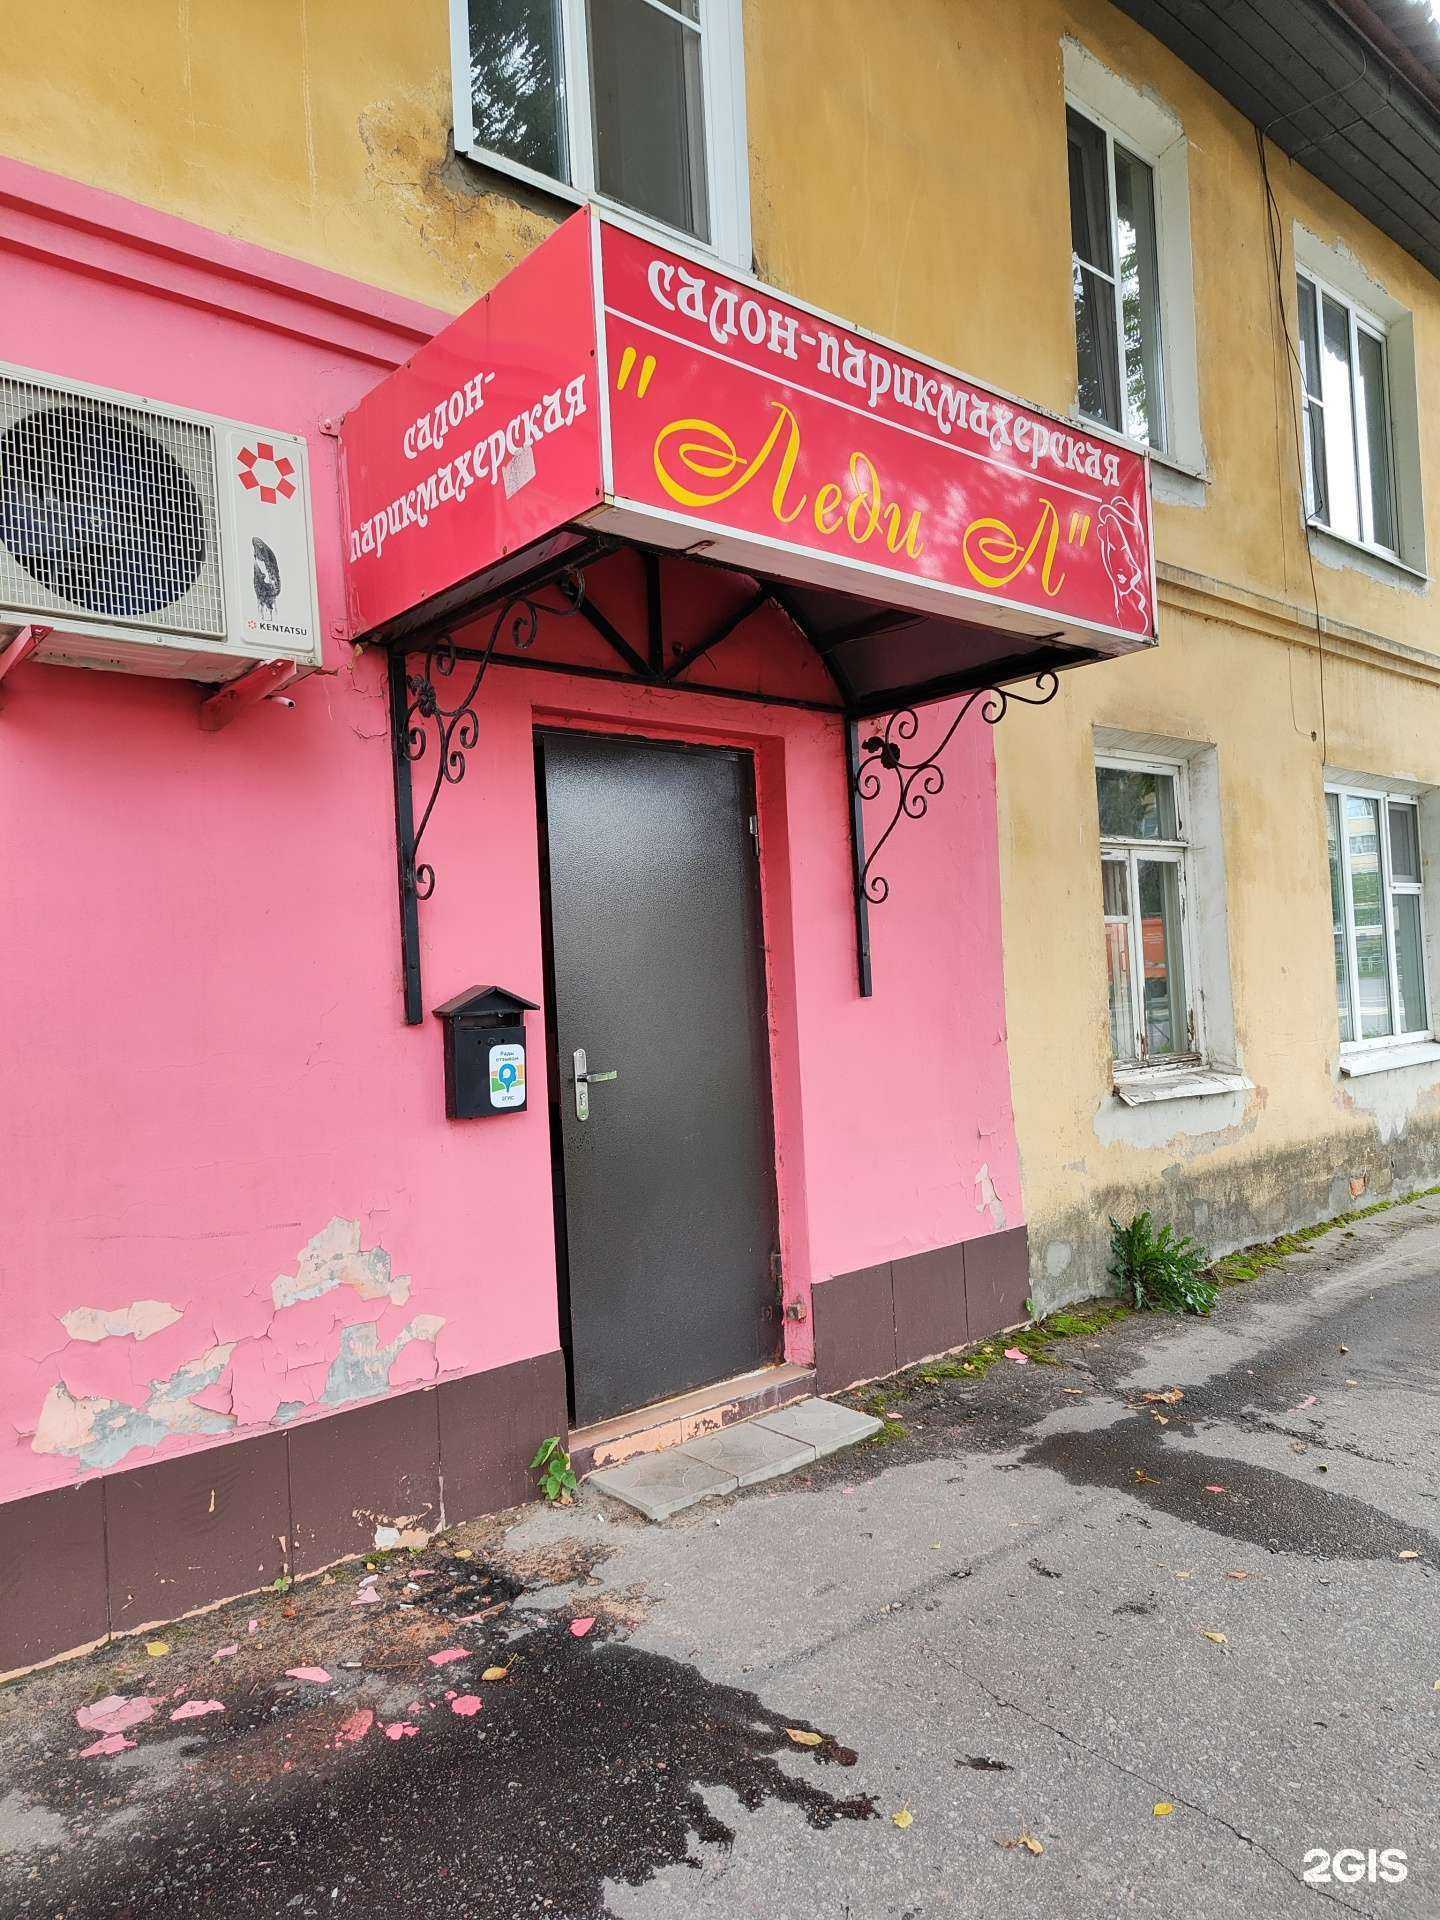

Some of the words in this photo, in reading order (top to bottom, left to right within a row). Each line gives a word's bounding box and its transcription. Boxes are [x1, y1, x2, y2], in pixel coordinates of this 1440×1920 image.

[403, 371, 496, 459] салон-
[648, 259, 1120, 487] салон-парикмахерская
[350, 374, 587, 563] парикмахерская
[260, 622, 307, 636] KENTATSU
